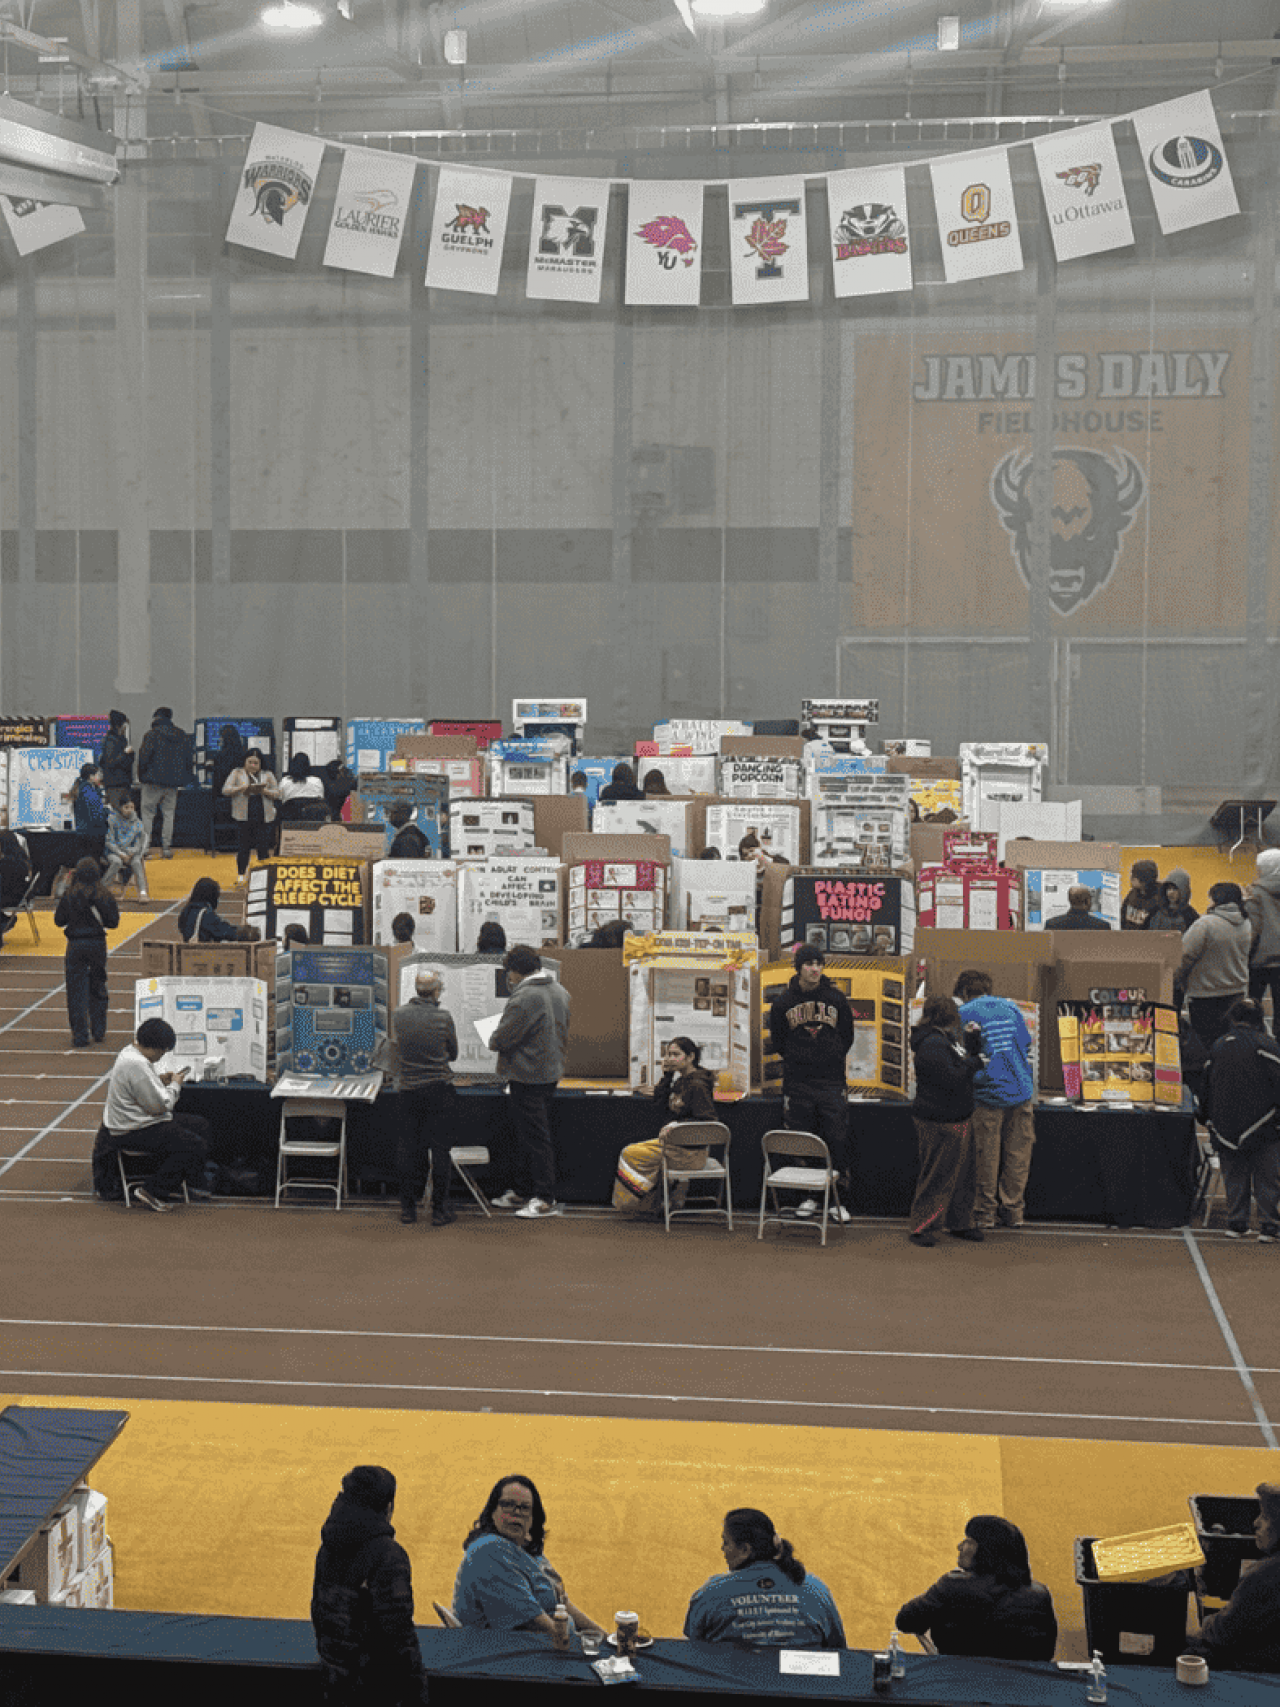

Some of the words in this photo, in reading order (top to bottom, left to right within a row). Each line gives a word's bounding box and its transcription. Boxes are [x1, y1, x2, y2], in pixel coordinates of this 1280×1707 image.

[244, 162, 312, 206] WARRIORS
[336, 207, 400, 233] LAURIER
[1051, 199, 1124, 226] uOttawa
[441, 233, 494, 249] GUELPH
[534, 256, 597, 268] McMASTER
[657, 251, 677, 270] YU
[1098, 351, 1231, 400] DALY
[733, 763, 784, 774] DANCING
[732, 773, 784, 783] POPCORN
[276, 866, 317, 880] DOES
[322, 866, 356, 881] DIET
[273, 879, 329, 894] AFFECT
[332, 880, 361, 895] THE
[501, 883, 533, 891] AFFECT
[814, 880, 886, 897] PLASTIC
[273, 891, 318, 906] SLEEP
[318, 892, 363, 907] CYCLE
[489, 891, 545, 900] DEVELOPING
[816, 893, 883, 911] EATING
[528, 900, 556, 908] BRAIN
[820, 906, 872, 922] FUNGI
[1089, 988, 1146, 1005] COLOUR
[1102, 1004, 1139, 1020] FIRE
[731, 1594, 799, 1606] VOLUNTEER
